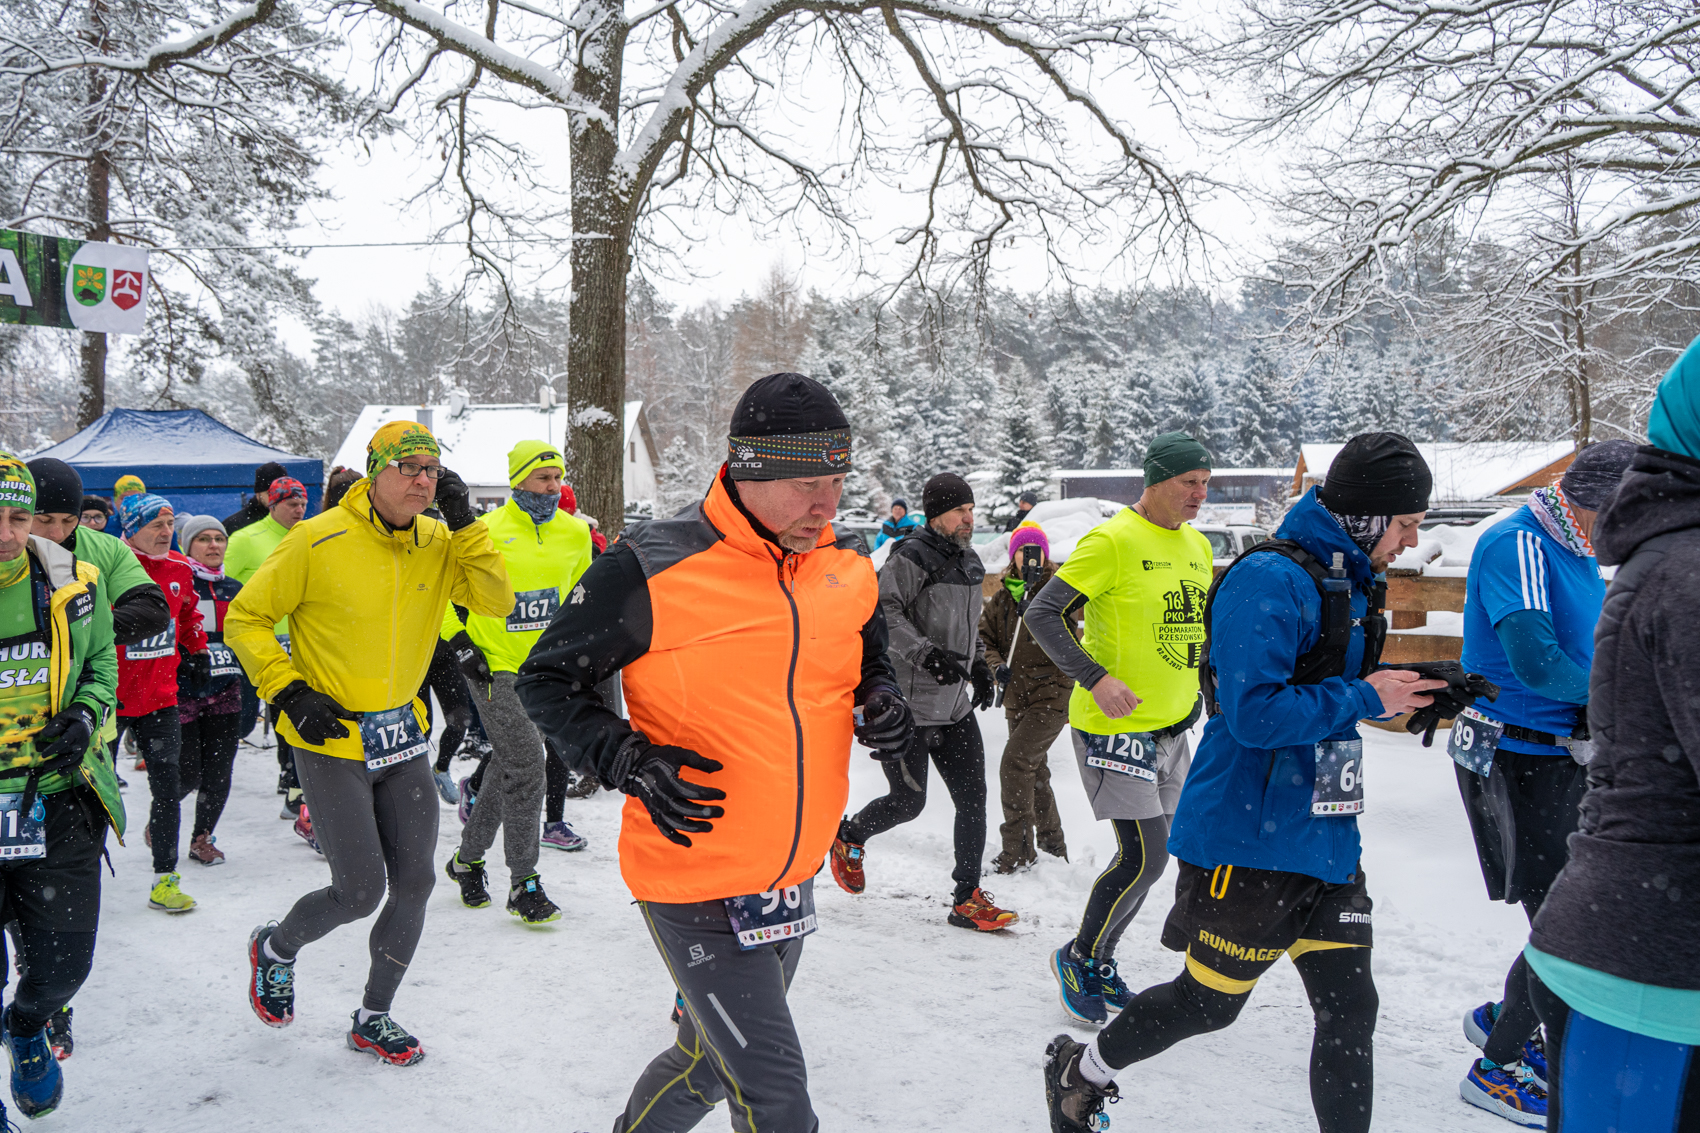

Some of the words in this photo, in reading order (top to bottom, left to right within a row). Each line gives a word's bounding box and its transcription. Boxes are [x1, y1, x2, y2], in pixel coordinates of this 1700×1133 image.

[0, 247, 34, 307] A
[0, 481, 31, 492] HURA
[518, 598, 549, 619] 167
[1165, 611, 1185, 622] PKO
[1158, 625, 1202, 633] PÓŁMARATON
[1158, 633, 1203, 641] RZESZOWSKI
[207, 649, 232, 665] 139
[0, 667, 51, 689] SŁA
[1105, 733, 1144, 761] 120
[1340, 759, 1363, 793] 64
[759, 885, 800, 915] 96
[687, 953, 715, 968] salomon
[256, 966, 265, 997] HOKA
